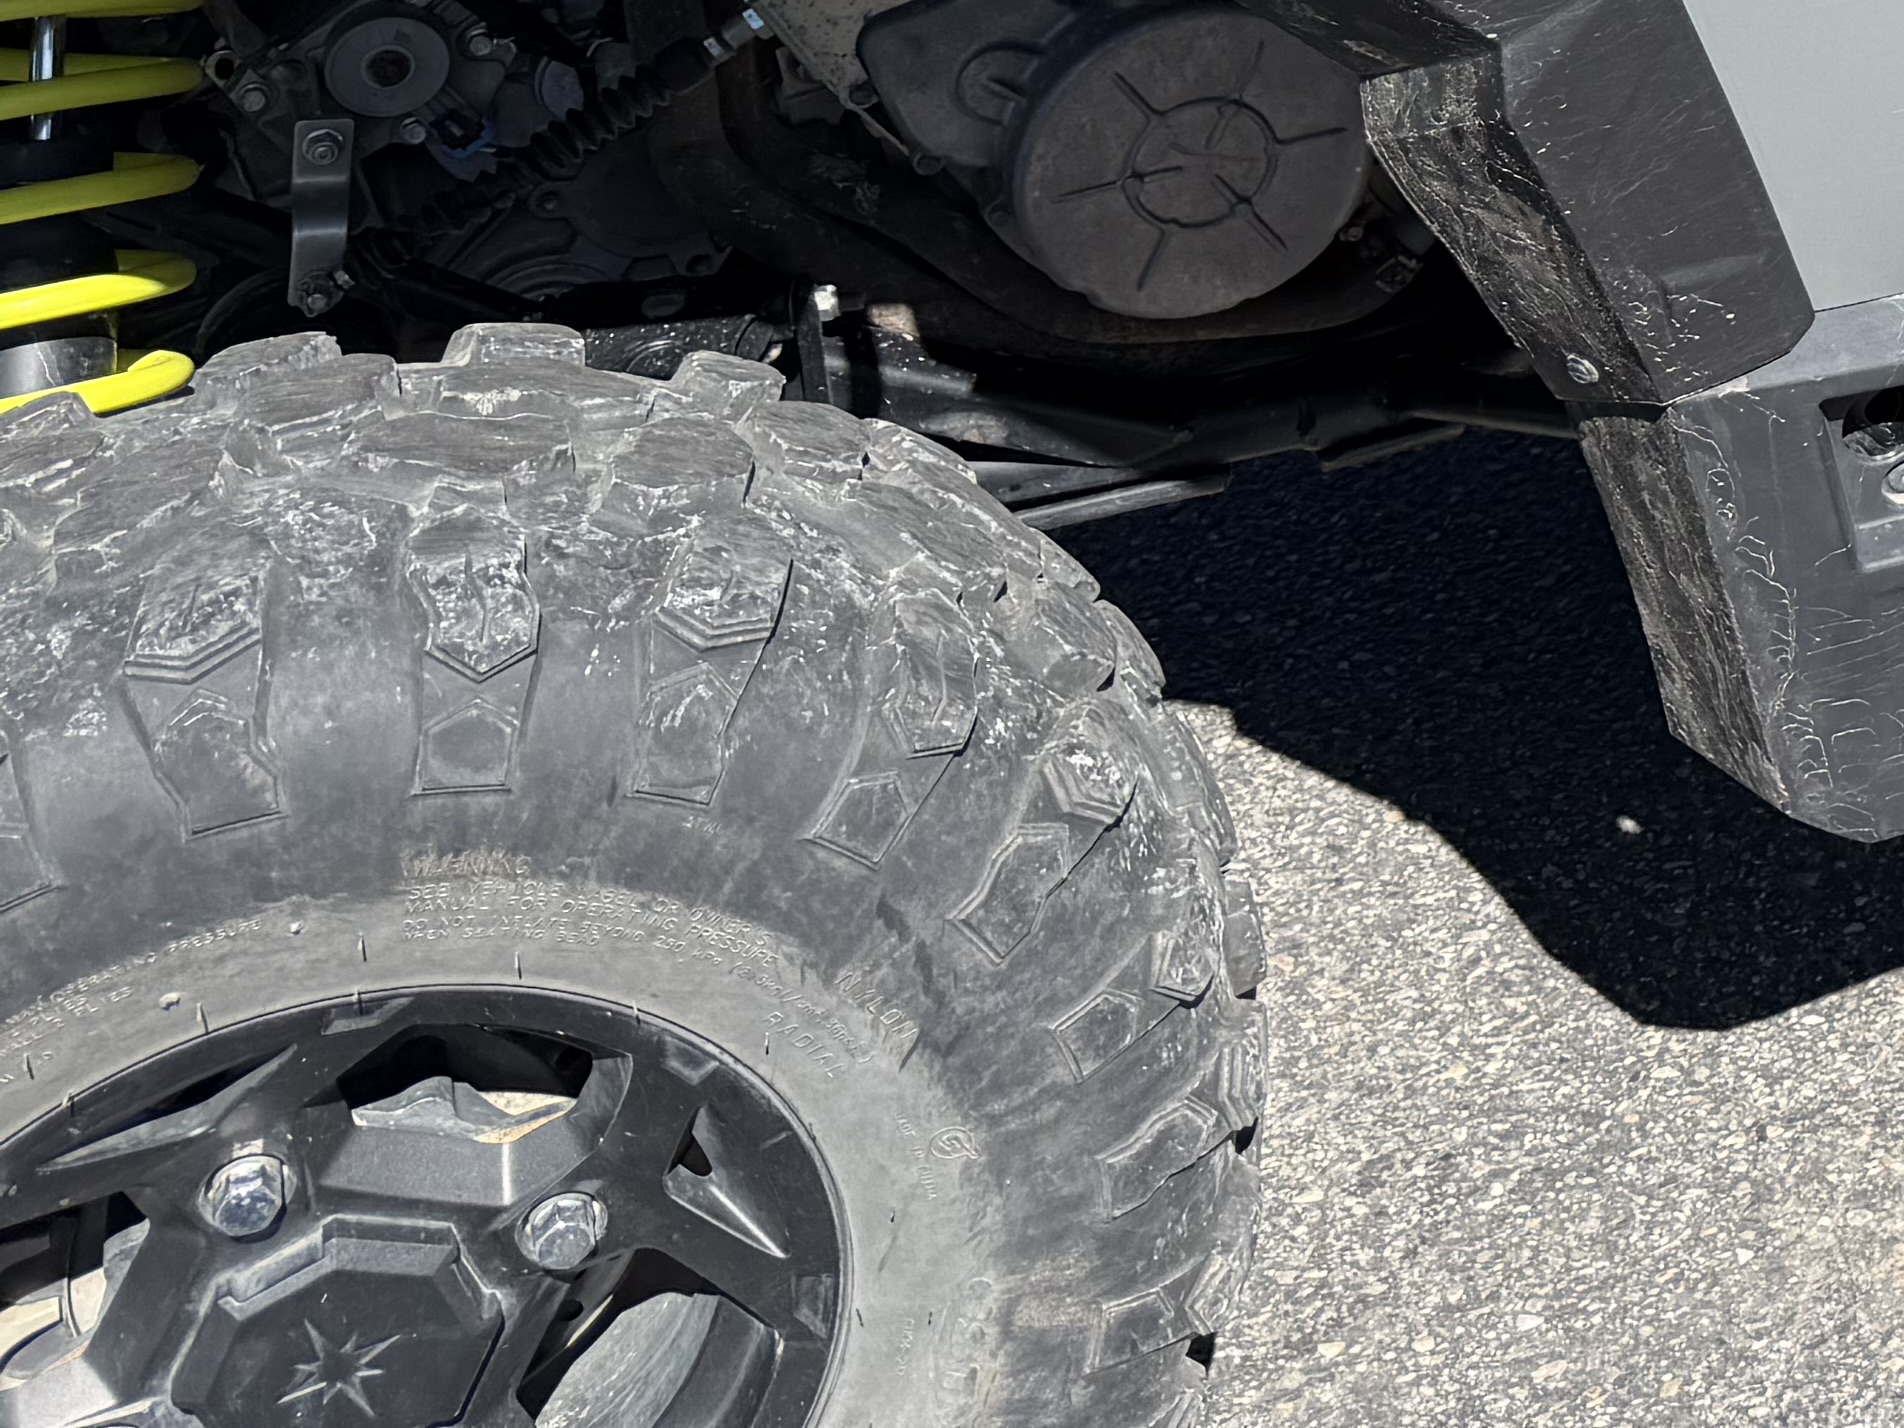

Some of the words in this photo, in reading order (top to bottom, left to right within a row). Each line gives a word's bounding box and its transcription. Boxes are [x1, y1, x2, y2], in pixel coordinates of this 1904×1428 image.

[408, 881, 451, 900] SEE
[469, 880, 564, 898] VEHICLE
[168, 918, 262, 954] PRESSURE
[405, 894, 489, 914] MANUAL
[507, 894, 548, 912] FOR
[560, 897, 678, 931] OPERATING
[686, 924, 780, 968] PRESSURE
[834, 970, 921, 1042] NYLON
[763, 1010, 844, 1079] RADIAL
